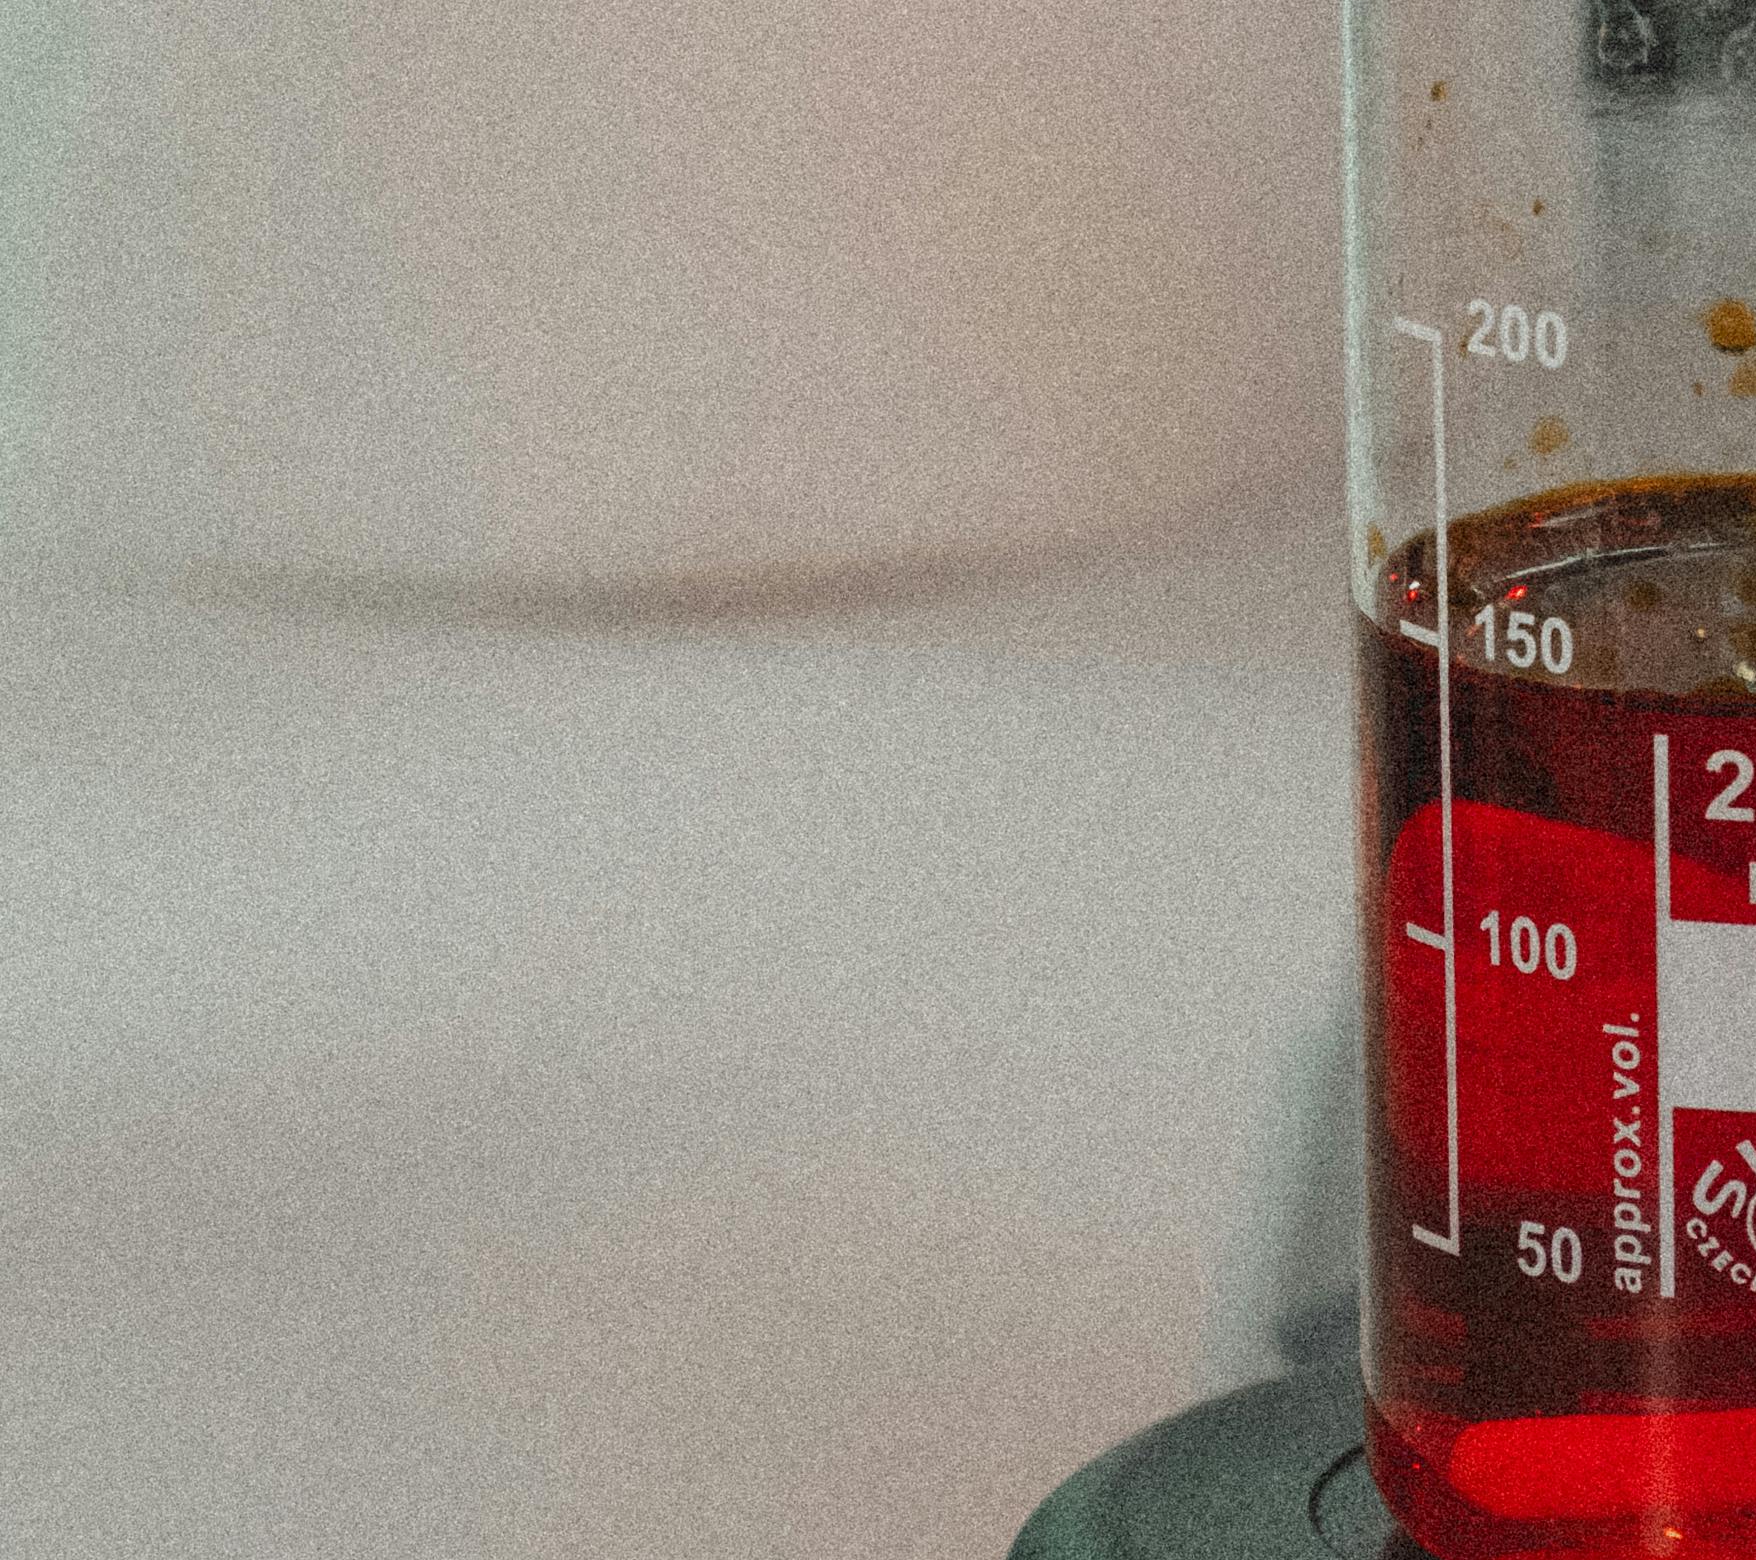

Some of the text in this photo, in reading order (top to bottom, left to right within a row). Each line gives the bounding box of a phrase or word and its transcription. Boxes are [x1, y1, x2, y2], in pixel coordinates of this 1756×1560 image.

[1466, 299, 1568, 369] 200
[1474, 603, 1573, 674] 150
[1480, 909, 1577, 980] 100
[1517, 1220, 1582, 1284] 50
